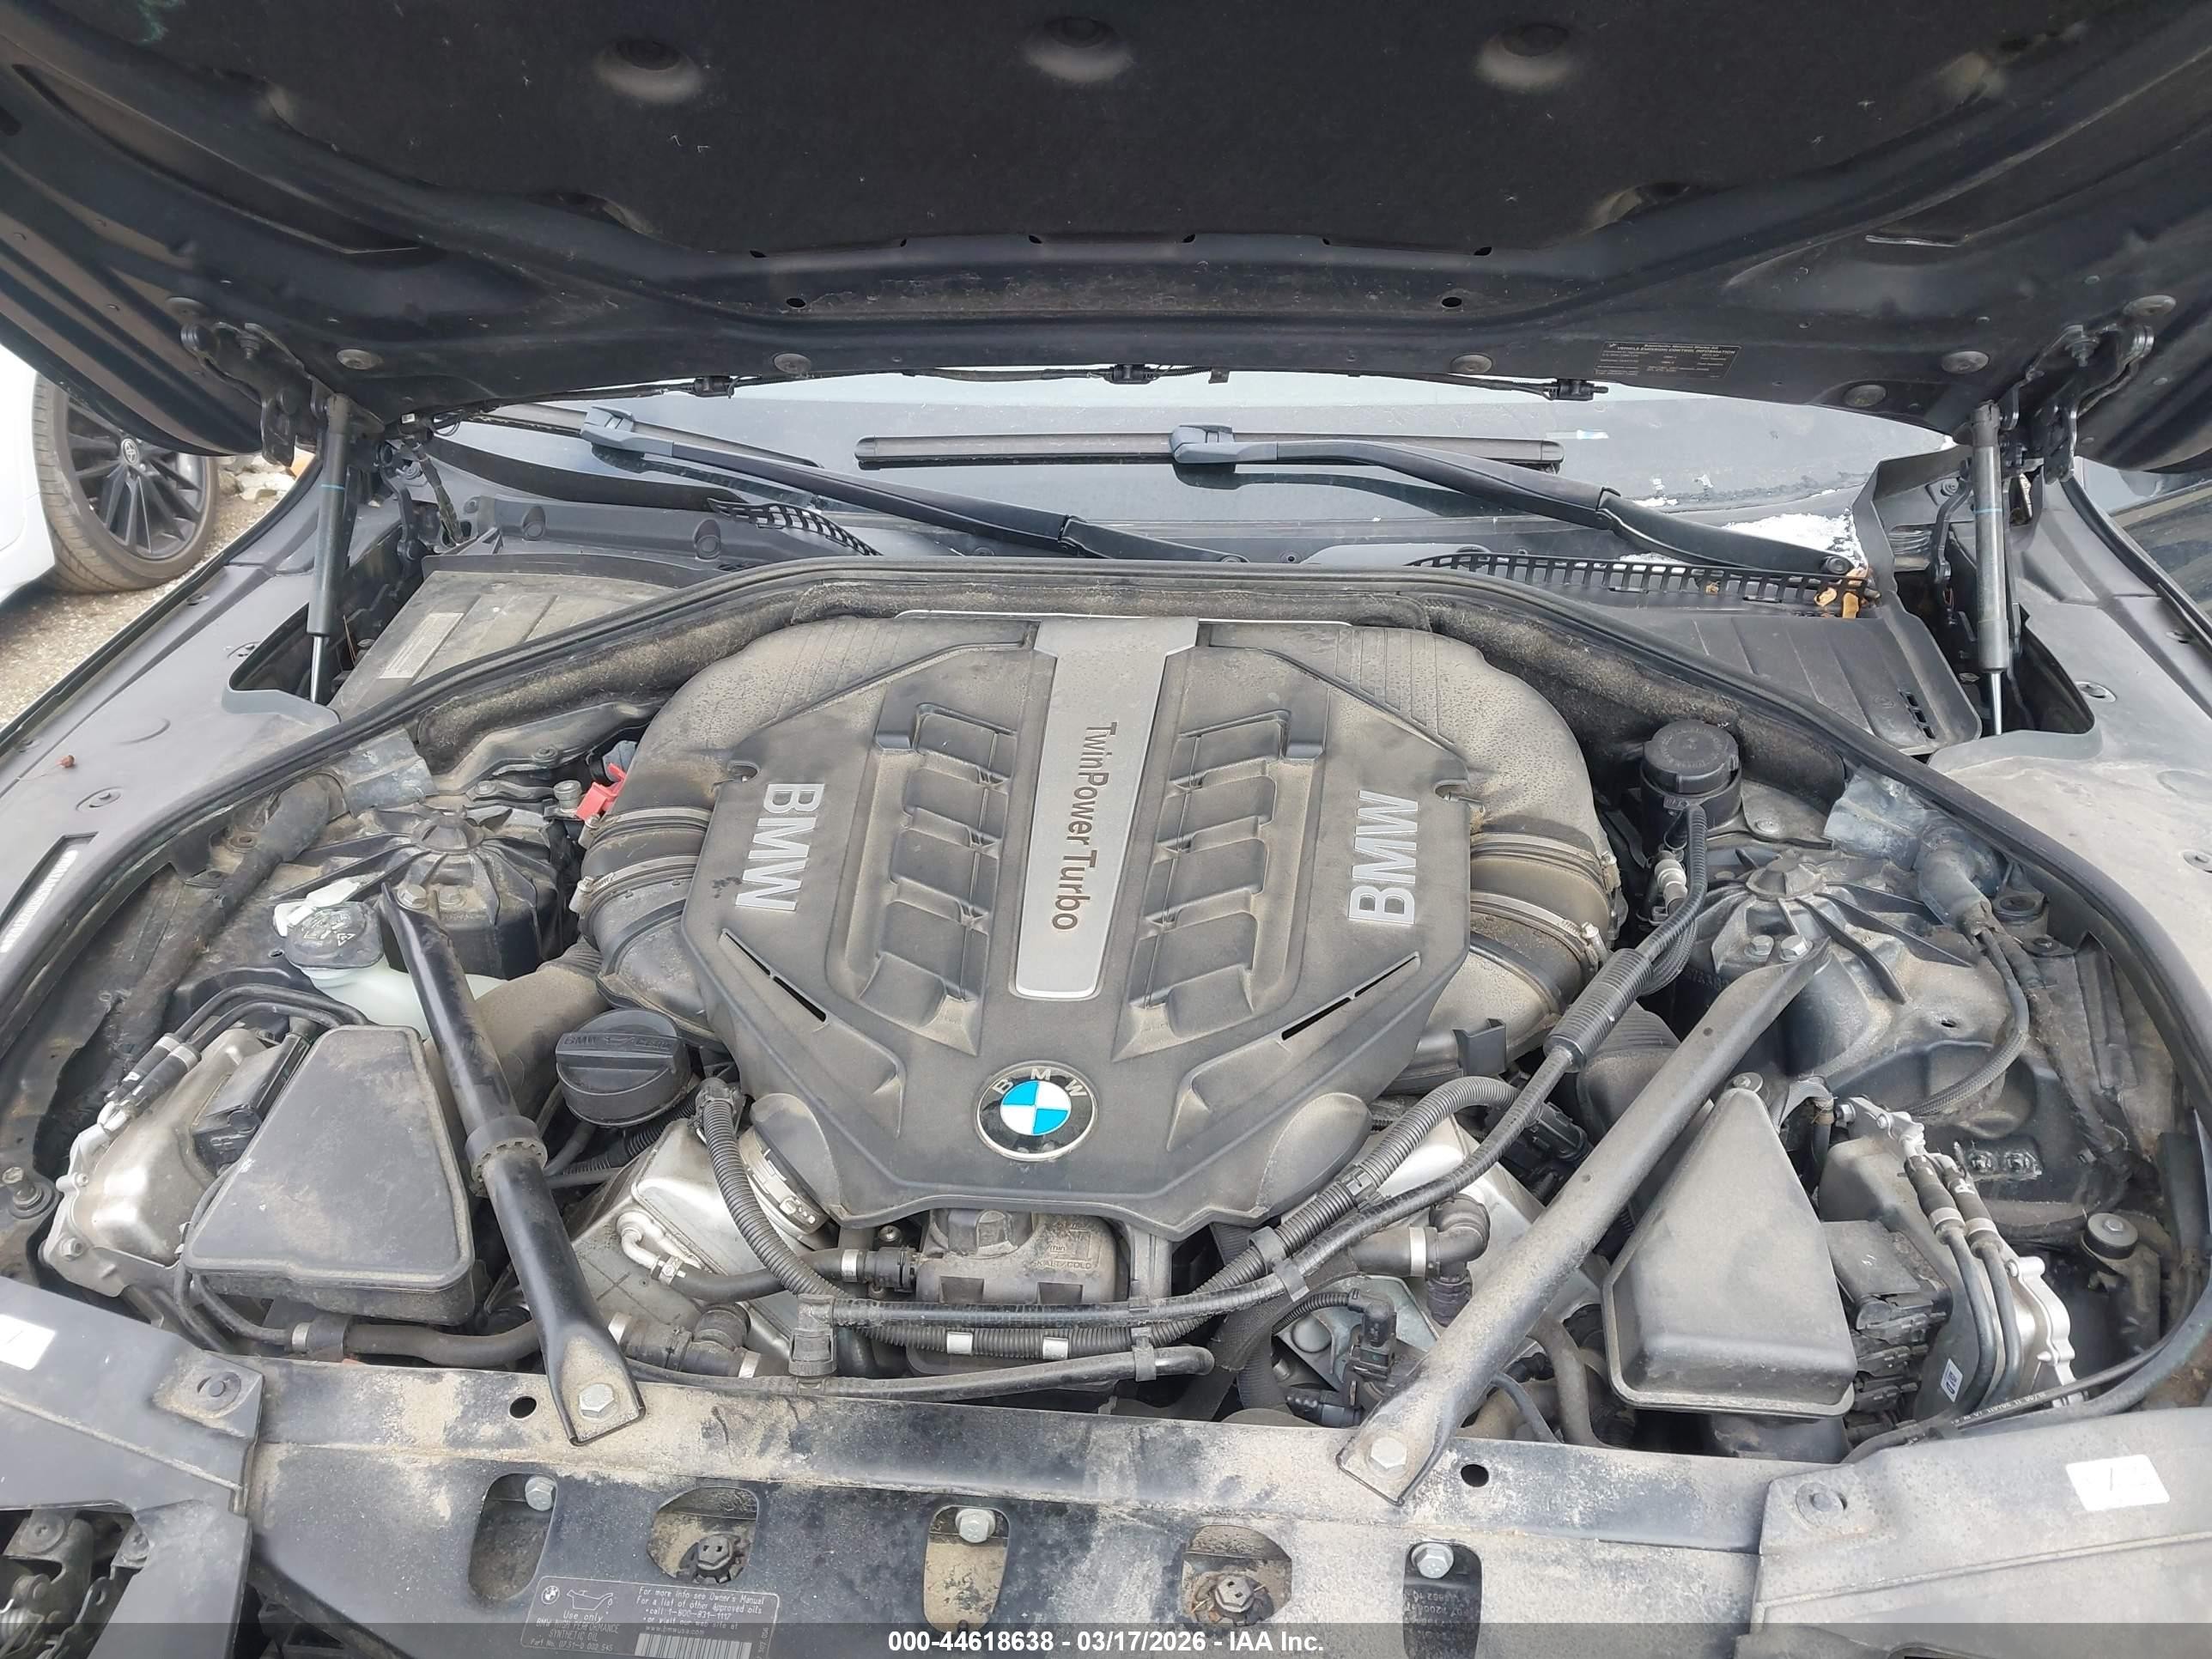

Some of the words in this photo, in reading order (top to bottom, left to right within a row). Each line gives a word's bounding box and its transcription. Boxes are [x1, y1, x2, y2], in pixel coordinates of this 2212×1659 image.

[1066, 721, 1118, 845] TwinPower
[735, 783, 824, 911] BMW
[1348, 790, 1419, 925] BMW
[1052, 850, 1098, 930] Turbo
[993, 1068, 1088, 1097] BMW
[636, 1595, 649, 1604] For
[661, 1597, 674, 1607] list
[678, 1599, 686, 1607] of
[690, 1600, 708, 1609] other
[639, 1586, 651, 1595] For
[676, 1589, 690, 1599] info
[709, 1592, 736, 1602] Owner's
[739, 1594, 764, 1605] Manual
[536, 1617, 550, 1627] BMW
[555, 1619, 572, 1630] HIGH
[572, 1620, 620, 1635] PERFORMANCE
[563, 1610, 578, 1620] Use
[584, 1613, 604, 1623] only
[714, 1620, 726, 1629] site
[549, 1629, 585, 1641] SYNTHETIC
[587, 1632, 599, 1642] OIL
